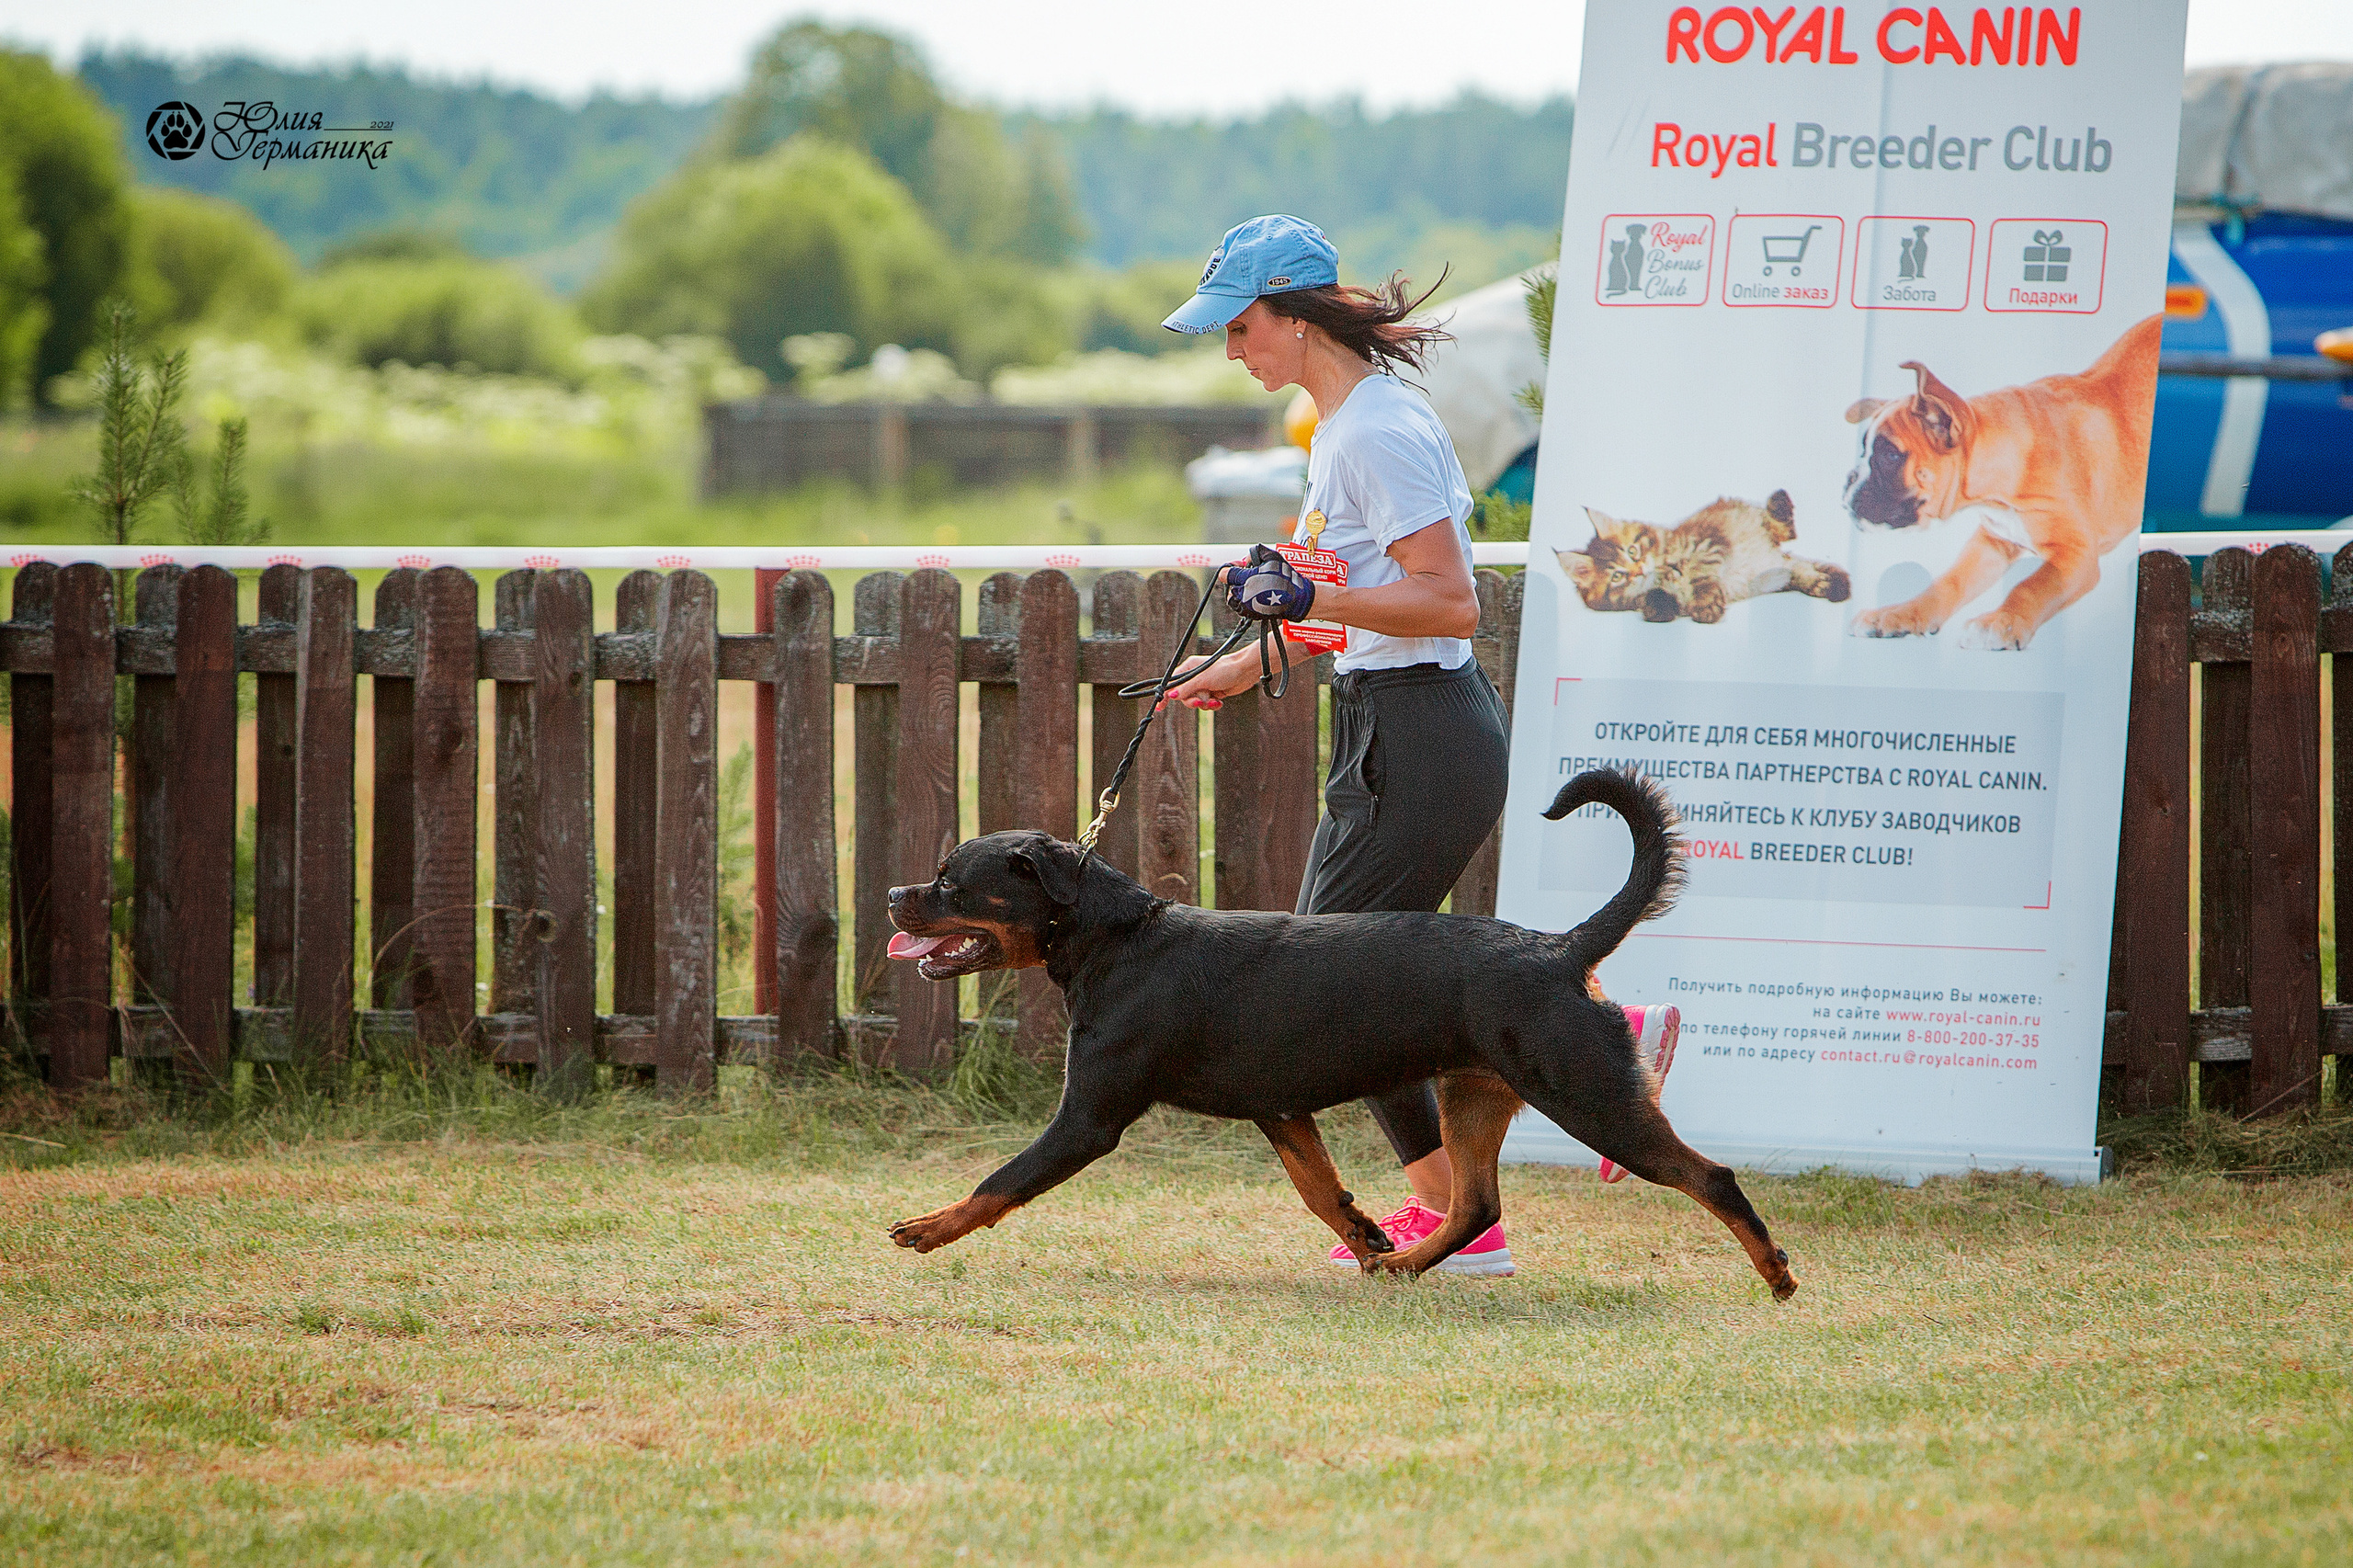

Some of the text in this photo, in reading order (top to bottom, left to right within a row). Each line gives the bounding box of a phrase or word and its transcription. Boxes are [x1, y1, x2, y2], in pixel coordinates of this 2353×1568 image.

[1666, 6, 2081, 66] ROYAL CANIN
[1652, 122, 2112, 178] Royal Breeder Club
[1651, 222, 1708, 252] Royal
[1647, 248, 1704, 273] Bonus
[1644, 275, 1688, 299] Club
[1732, 283, 1828, 300] Online заказ
[1883, 285, 1937, 301] Забота
[2009, 288, 2077, 307] Подарки
[1596, 721, 2017, 754] ОТКРОЙТЕ ДЛЯ СЕБЯ МНОГОЧИСЛЕННЫЕ
[1736, 762, 1883, 785] ПАРТНЕРСТВА
[1889, 768, 1902, 786] С
[1908, 768, 1972, 789] ROYAL
[1979, 771, 2047, 790] CANIN.
[1791, 808, 1803, 825] К
[1810, 809, 1877, 828] КЛУБУ
[1882, 812, 2020, 835] ЗАВОДЧИКОВ
[1751, 842, 1846, 863] BREEDER
[1852, 846, 1913, 866] CLUB!
[1668, 977, 2041, 1005] Получить подробную информацию Вы можете:
[1813, 1006, 2041, 1028] на сайте www.royal-canin.ru
[1680, 1023, 2040, 1049] по телефону горячей линии 8-800-200-37-35
[1703, 1046, 2039, 1070] или по адресу contact.ru@royalcanin.com
